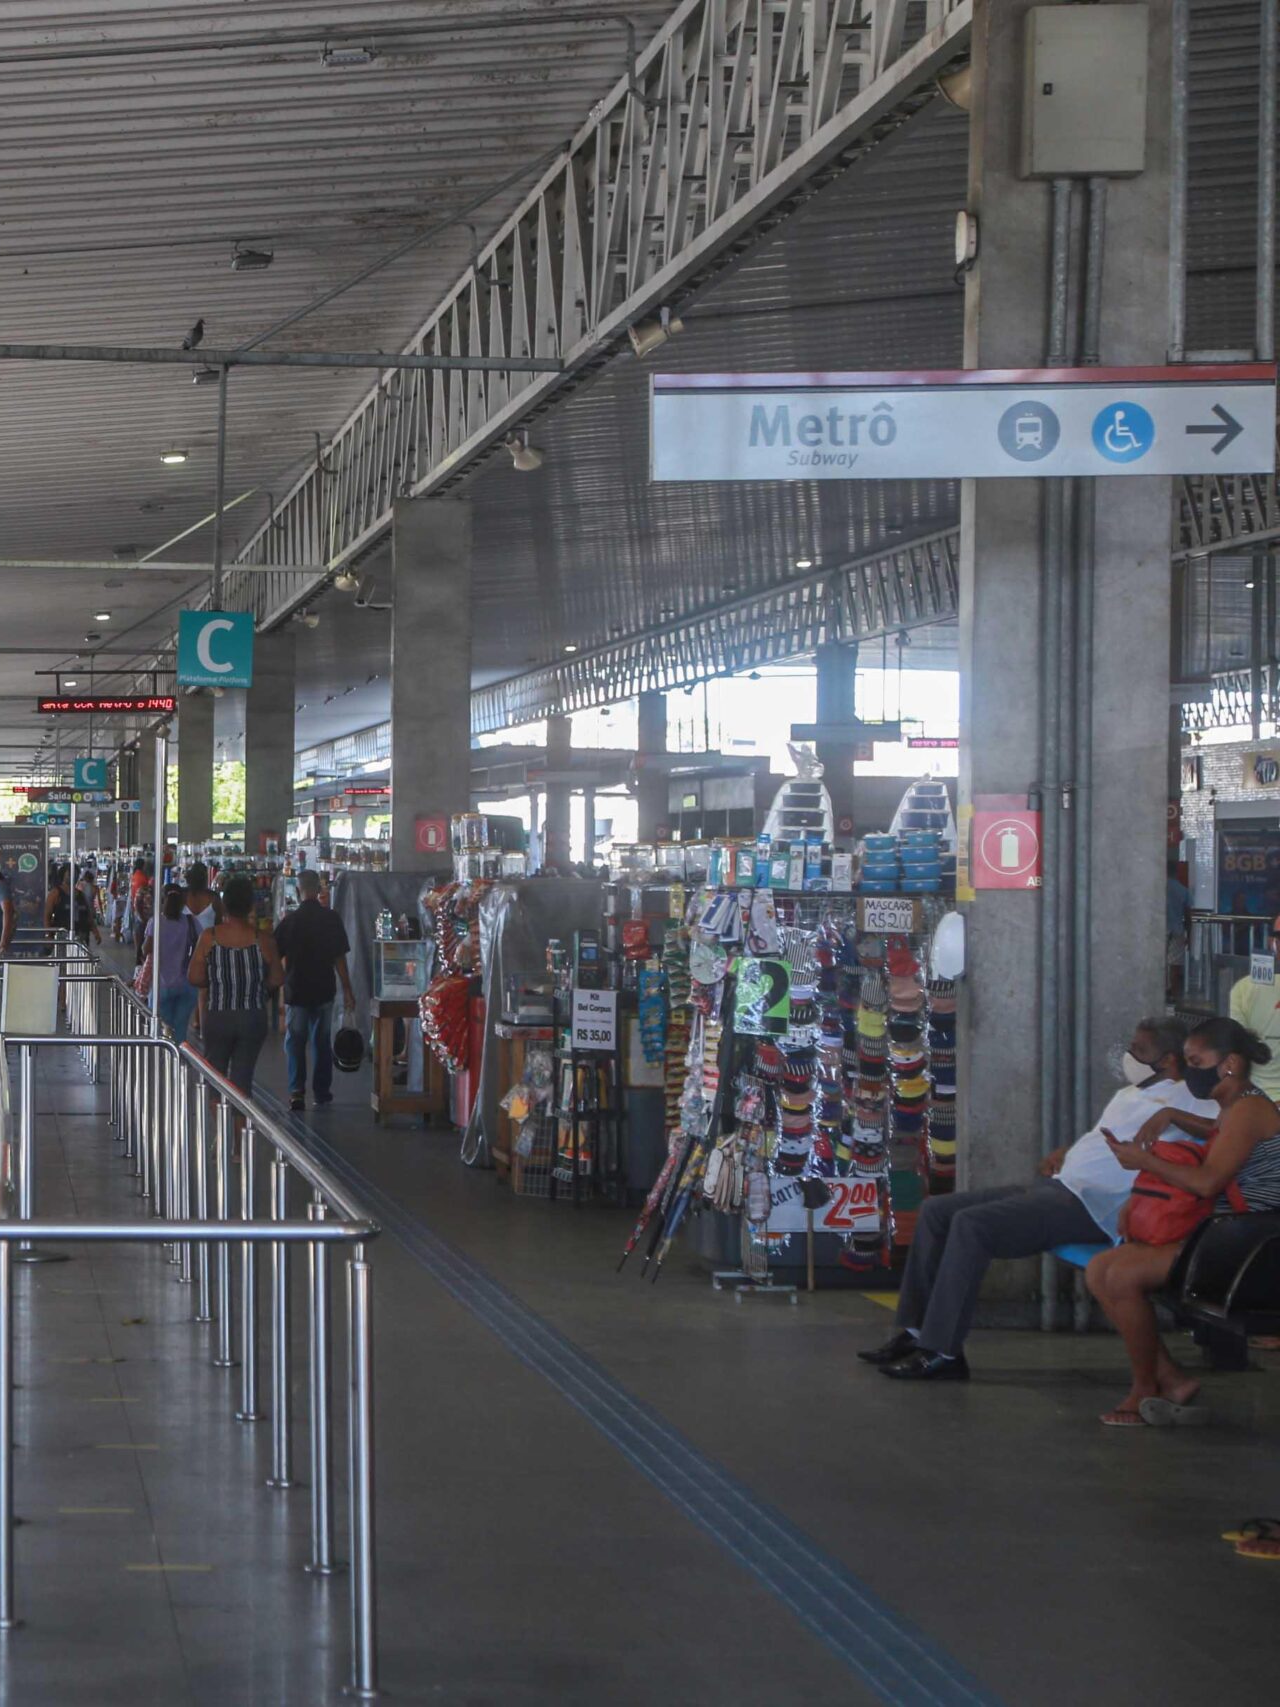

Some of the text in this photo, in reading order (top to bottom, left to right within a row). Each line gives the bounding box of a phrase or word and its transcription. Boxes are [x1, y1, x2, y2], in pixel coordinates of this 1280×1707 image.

[748, 401, 897, 447] Metrô
[787, 449, 859, 469] Subway
[197, 619, 234, 673] C
[81, 761, 97, 785] C
[48, 791, 71, 800] Saída
[590, 993, 600, 1001] Kit
[577, 1003, 612, 1014] Bel Corpus
[589, 1030, 612, 1043] 35,00
